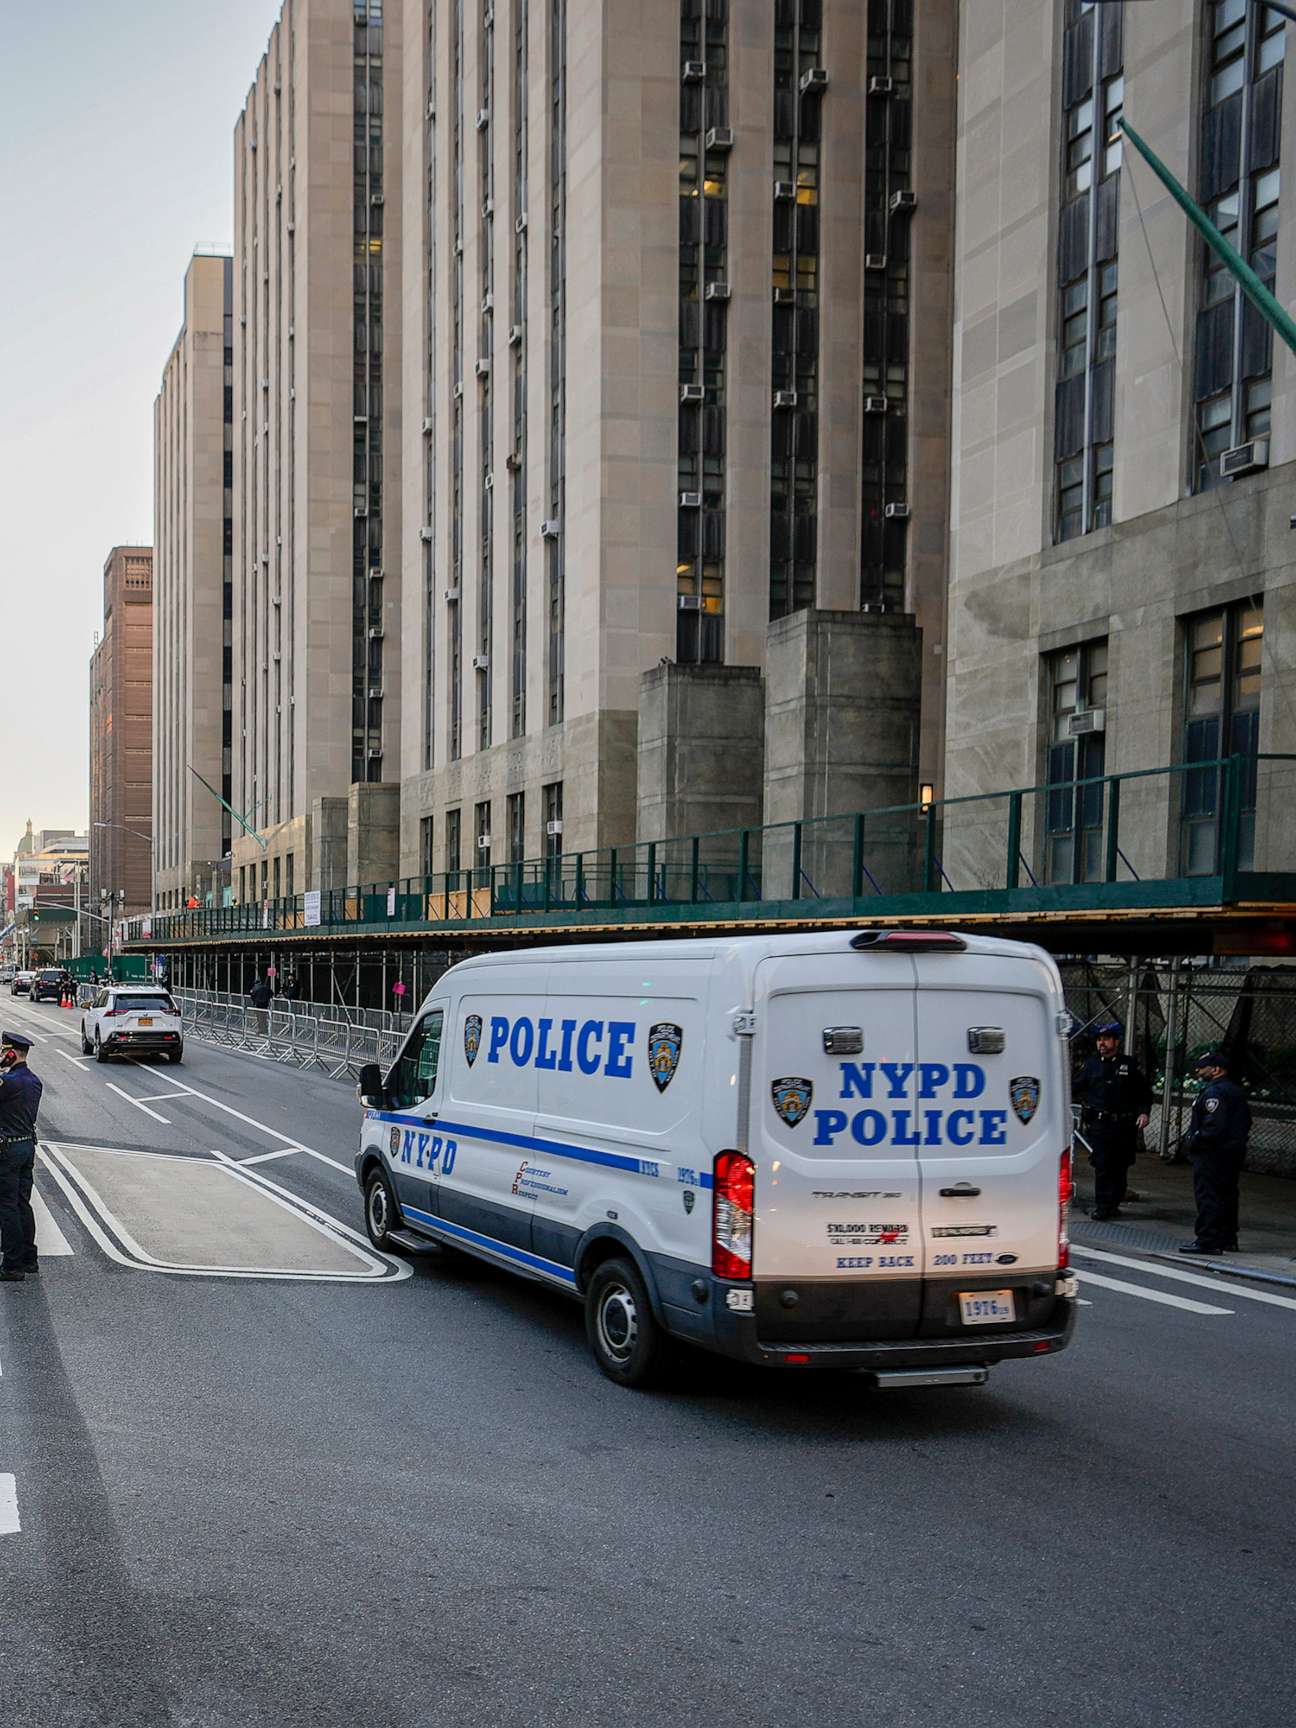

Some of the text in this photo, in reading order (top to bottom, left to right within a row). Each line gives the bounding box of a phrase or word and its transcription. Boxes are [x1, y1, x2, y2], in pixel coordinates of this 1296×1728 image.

[487, 1016, 636, 1078] POLICE
[839, 1062, 986, 1099] NYPD
[812, 1109, 1008, 1146] POLICE
[401, 1129, 458, 1176] NYPD
[869, 1224, 909, 1233] REWARD
[836, 1257, 873, 1268] KEEP
[879, 1256, 914, 1267] BACK
[933, 1255, 958, 1265] 200
[962, 1253, 992, 1264] FEET
[965, 1300, 997, 1317] 1976
